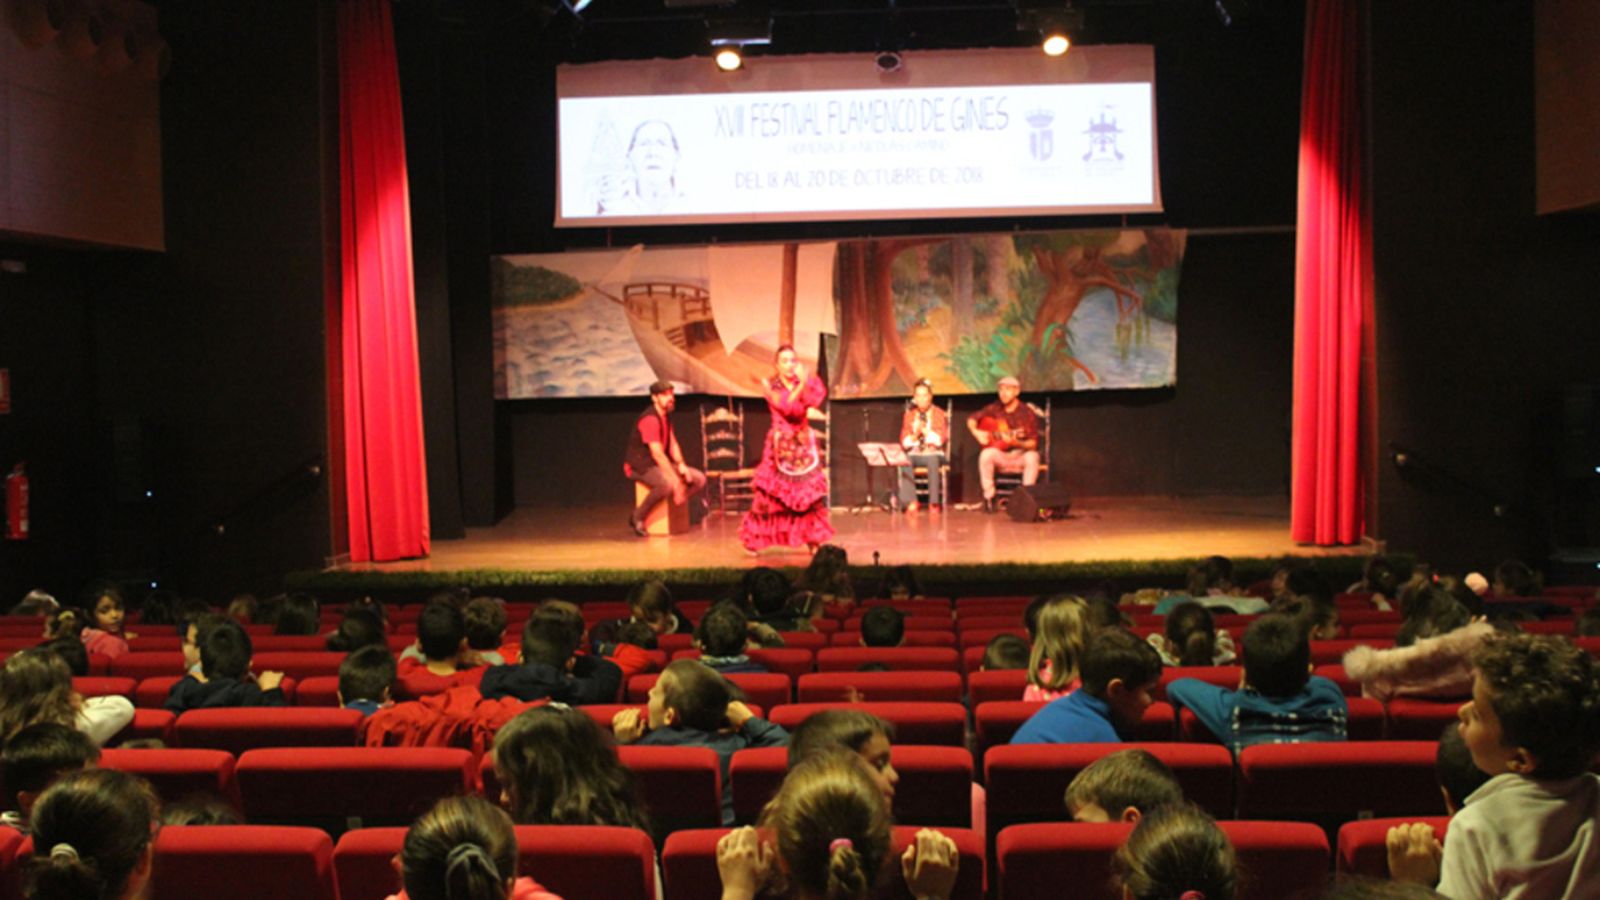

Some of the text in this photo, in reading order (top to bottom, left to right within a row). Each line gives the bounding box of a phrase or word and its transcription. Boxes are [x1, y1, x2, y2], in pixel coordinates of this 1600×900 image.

[750, 101, 823, 137] FESTIVAL
[827, 98, 916, 135] FLAMENCO
[920, 96, 945, 133] DE
[950, 95, 1010, 132] GINES
[734, 171, 763, 190] DEL
[783, 169, 803, 188] AL
[807, 169, 826, 187] 20
[828, 168, 849, 187] DE
[853, 167, 922, 186] OCTUBRE
[929, 166, 950, 185] DE
